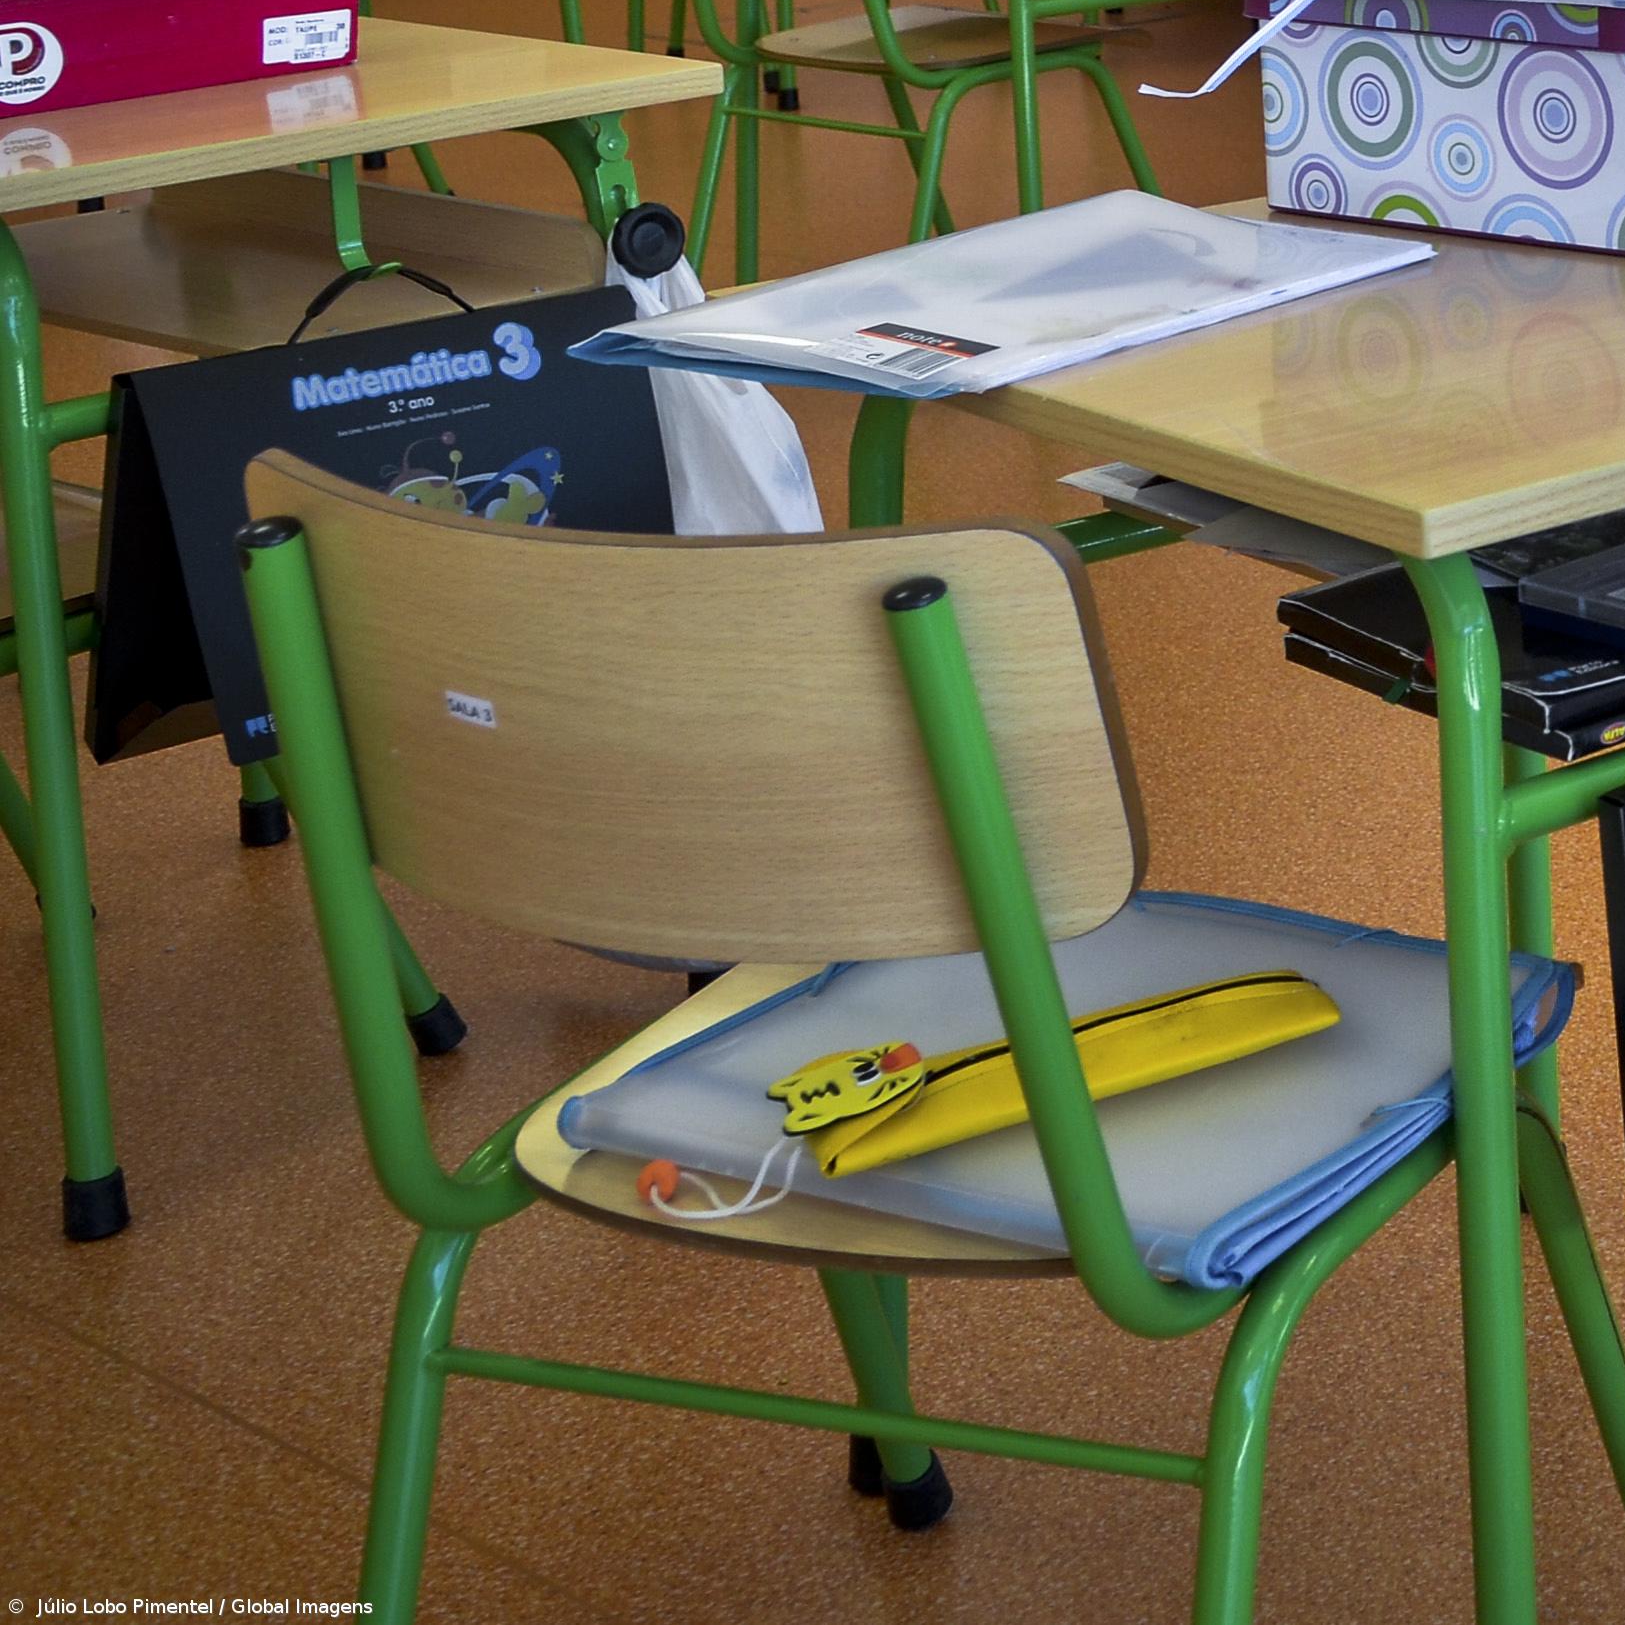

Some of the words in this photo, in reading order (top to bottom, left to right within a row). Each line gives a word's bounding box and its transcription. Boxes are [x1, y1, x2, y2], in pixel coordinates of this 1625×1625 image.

[292, 347, 493, 411] Matemática
[493, 322, 542, 381] 3
[408, 395, 435, 411] ano
